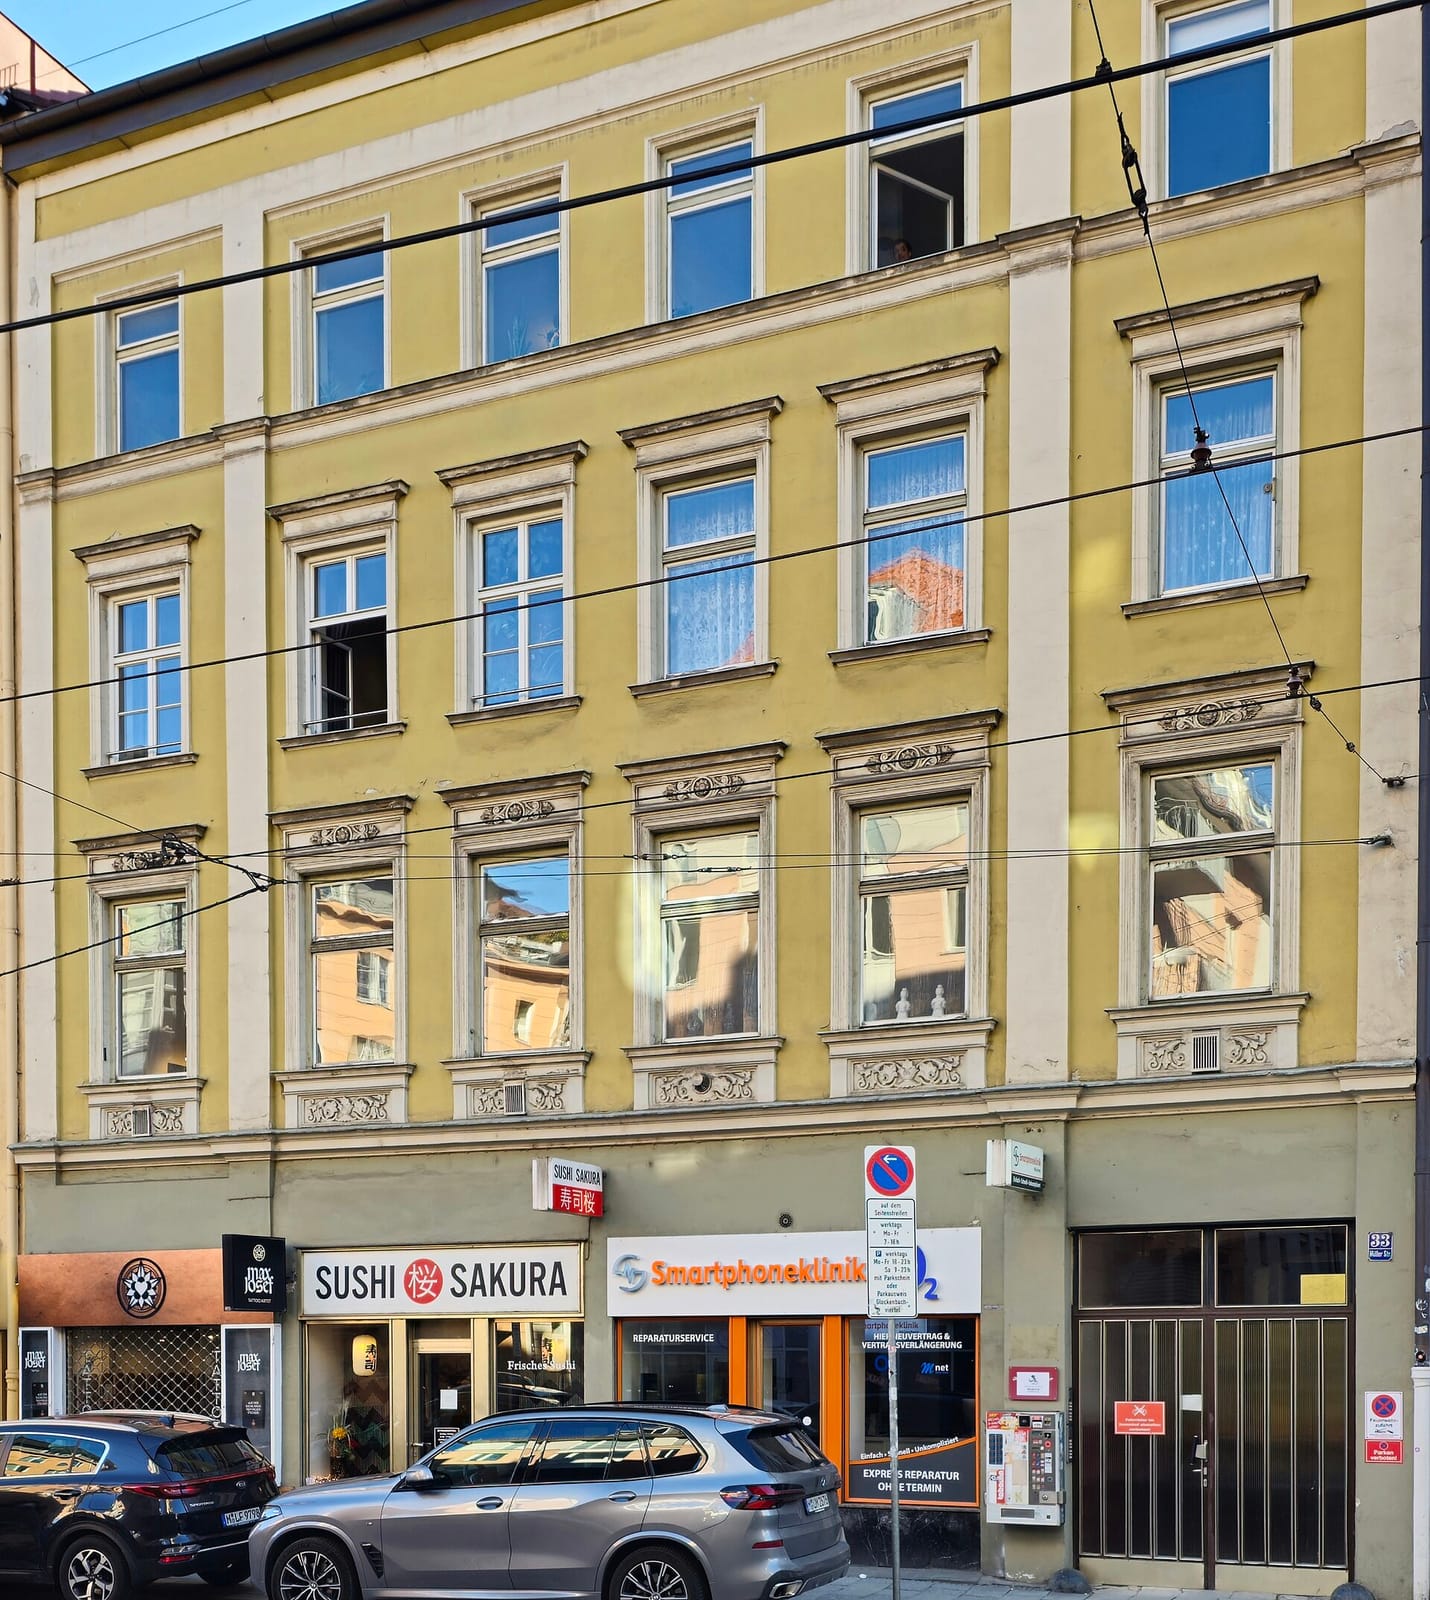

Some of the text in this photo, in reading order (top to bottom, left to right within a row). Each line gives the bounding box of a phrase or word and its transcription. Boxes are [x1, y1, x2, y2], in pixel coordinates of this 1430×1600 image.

[554, 1164, 601, 1186] SUSHI SAKURA
[560, 1187, 596, 1214] 寿司桜
[880, 1222, 903, 1230] werktags
[1370, 1233, 1391, 1248] 33
[450, 1261, 568, 1298] SAKURA
[651, 1256, 867, 1290] Smartphoneklinik
[315, 1265, 395, 1300] SUSHI
[408, 1264, 438, 1299] 桜
[632, 1333, 715, 1343] REPARATURSERVICE
[943, 1332, 951, 1341] &
[861, 1340, 963, 1350] VERTRASVERLÄNGERUNG
[507, 1360, 576, 1371] Frisches Sushi
[934, 1364, 950, 1373] net
[860, 1452, 884, 1460] Einfach
[914, 1436, 959, 1453] Unkompliziert
[863, 1469, 960, 1481] EXPRES REPARATUR
[877, 1482, 943, 1494] OHE TERMIN
